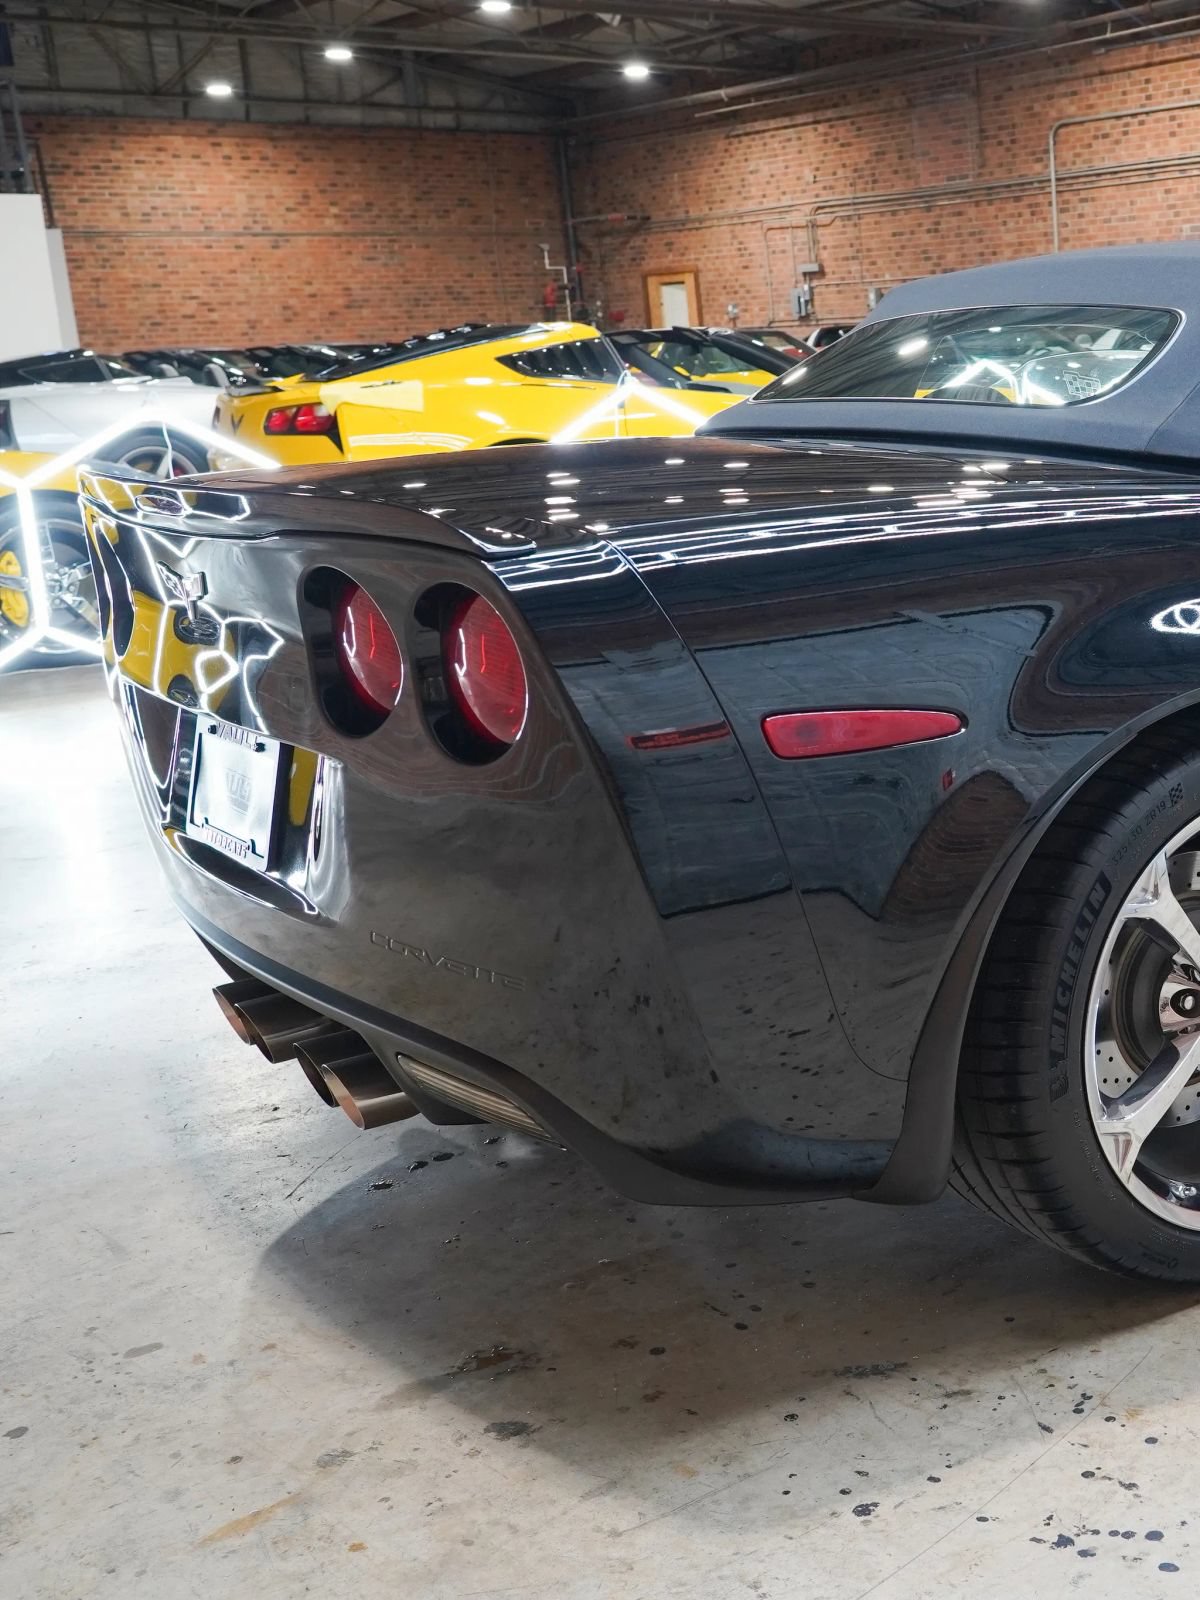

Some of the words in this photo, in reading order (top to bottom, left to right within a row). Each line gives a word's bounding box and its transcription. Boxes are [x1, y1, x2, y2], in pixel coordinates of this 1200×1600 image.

[1143, 798, 1168, 827] ZR19
[370, 930, 526, 992] CORVETTE
[1053, 878, 1109, 1053] MICHELIN
